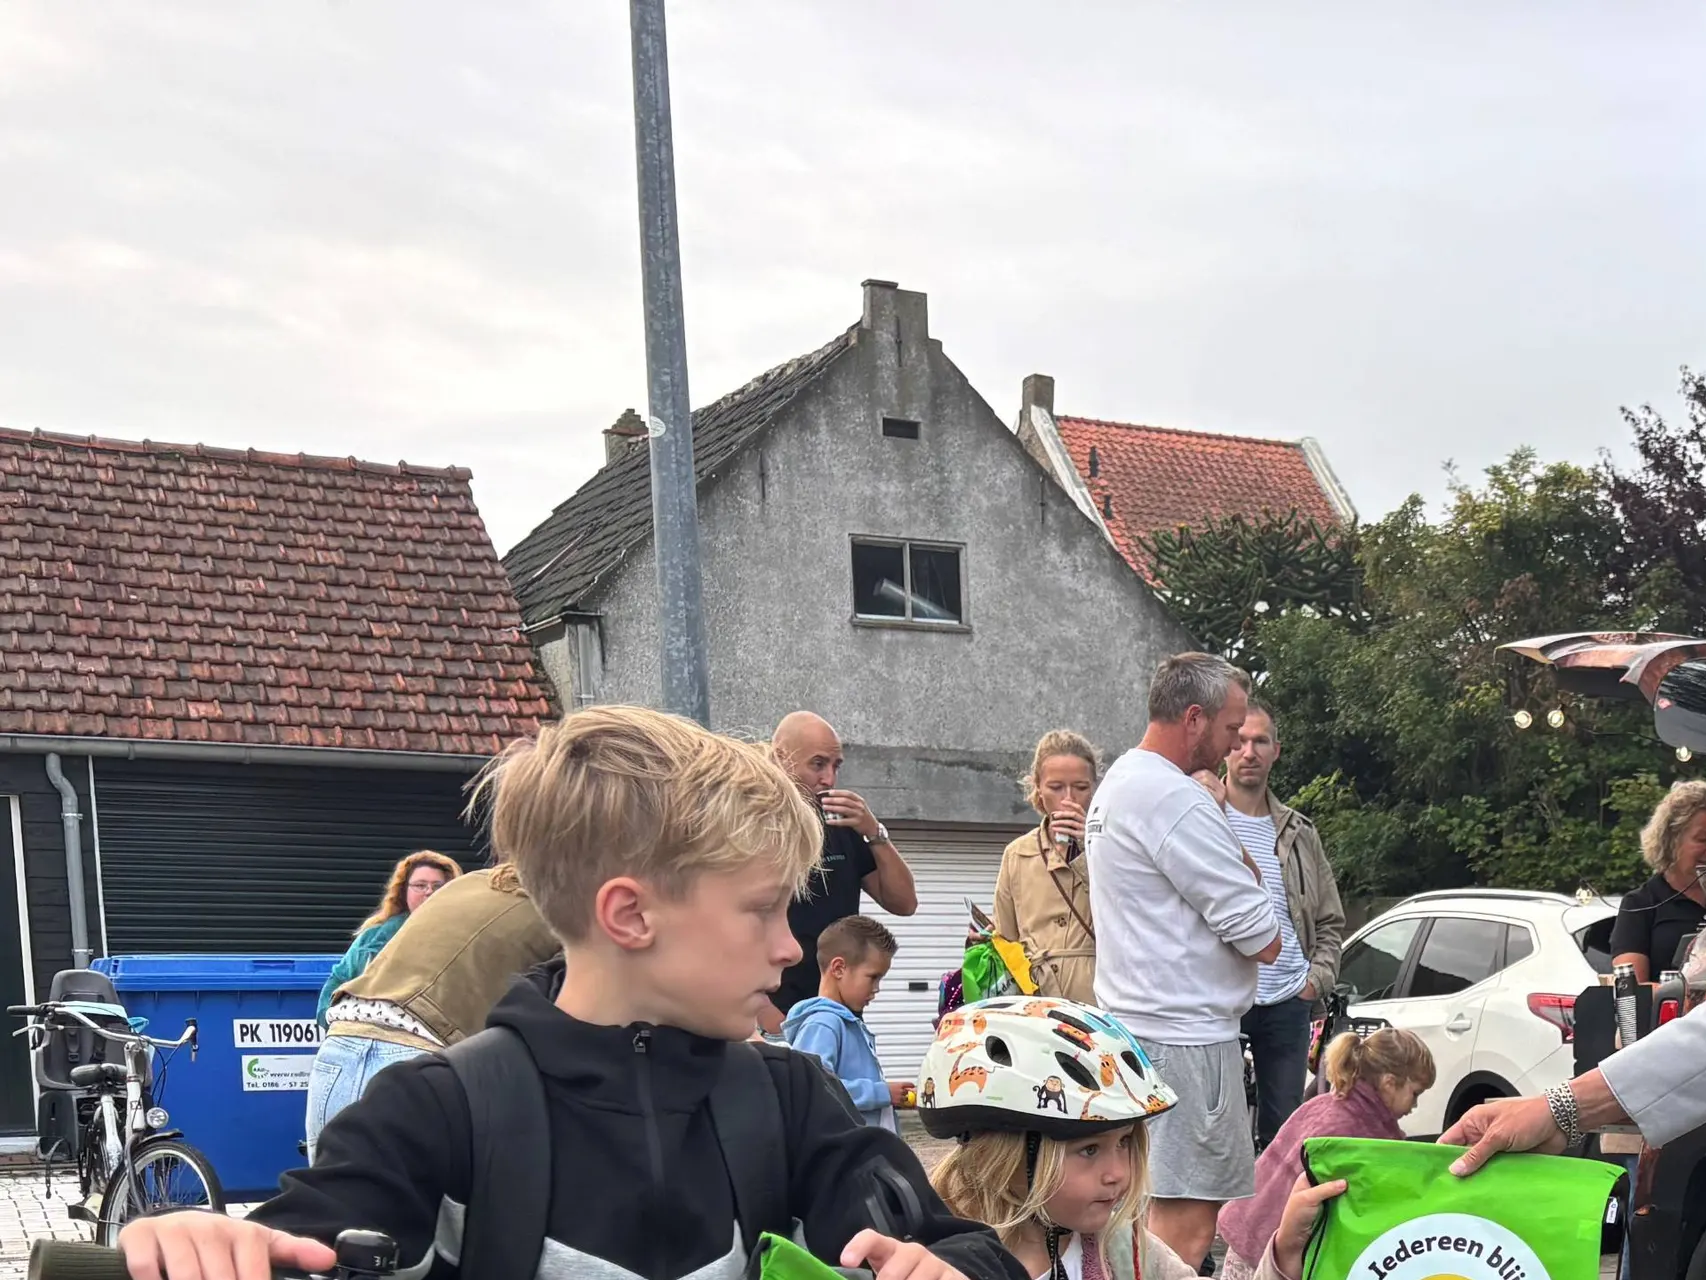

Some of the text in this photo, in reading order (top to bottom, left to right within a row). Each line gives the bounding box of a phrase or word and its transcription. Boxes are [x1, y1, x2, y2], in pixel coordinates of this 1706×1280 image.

[239, 1023, 321, 1042] PK 119061
[1368, 1235, 1484, 1280] Iedereen
